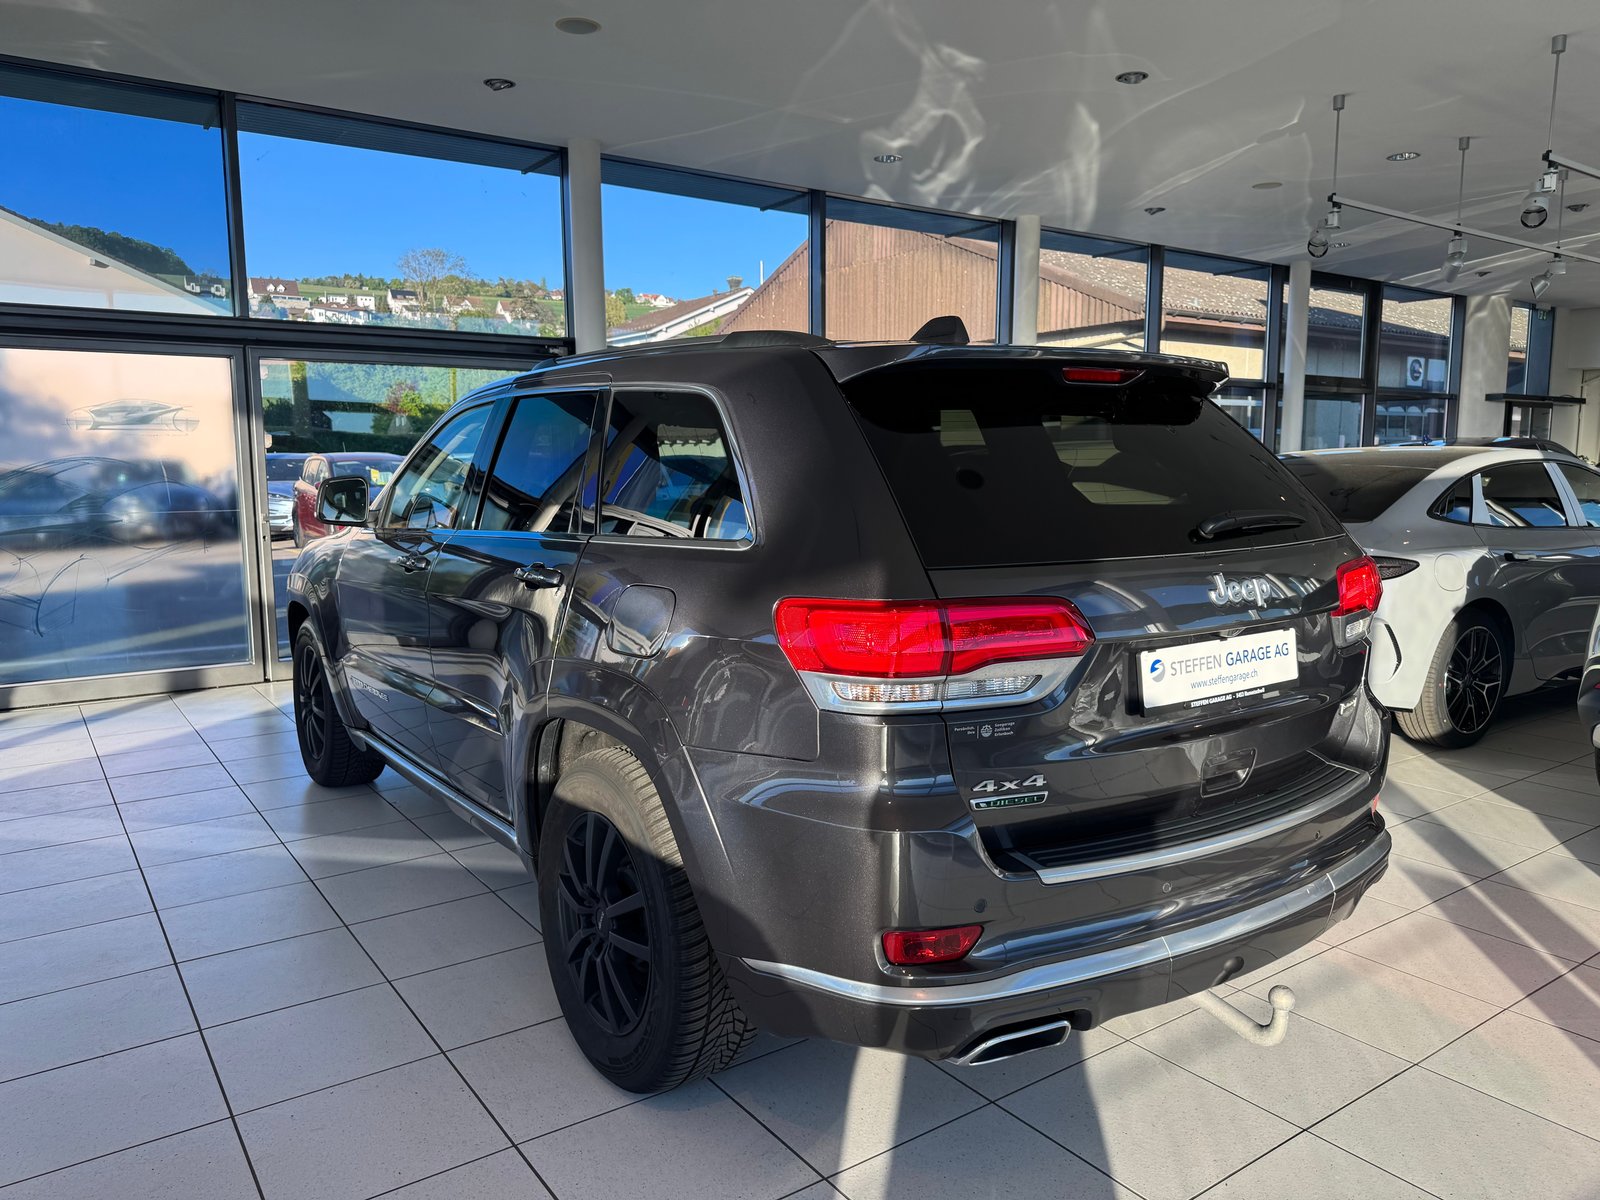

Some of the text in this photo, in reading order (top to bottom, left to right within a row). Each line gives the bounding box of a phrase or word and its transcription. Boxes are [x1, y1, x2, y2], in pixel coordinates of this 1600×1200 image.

[1207, 572, 1271, 609] Jeep
[1170, 642, 1290, 677] STEFFEN GARAGE AG
[1190, 668, 1259, 689] www.steffengarage.ch
[972, 774, 1047, 793] 4x4
